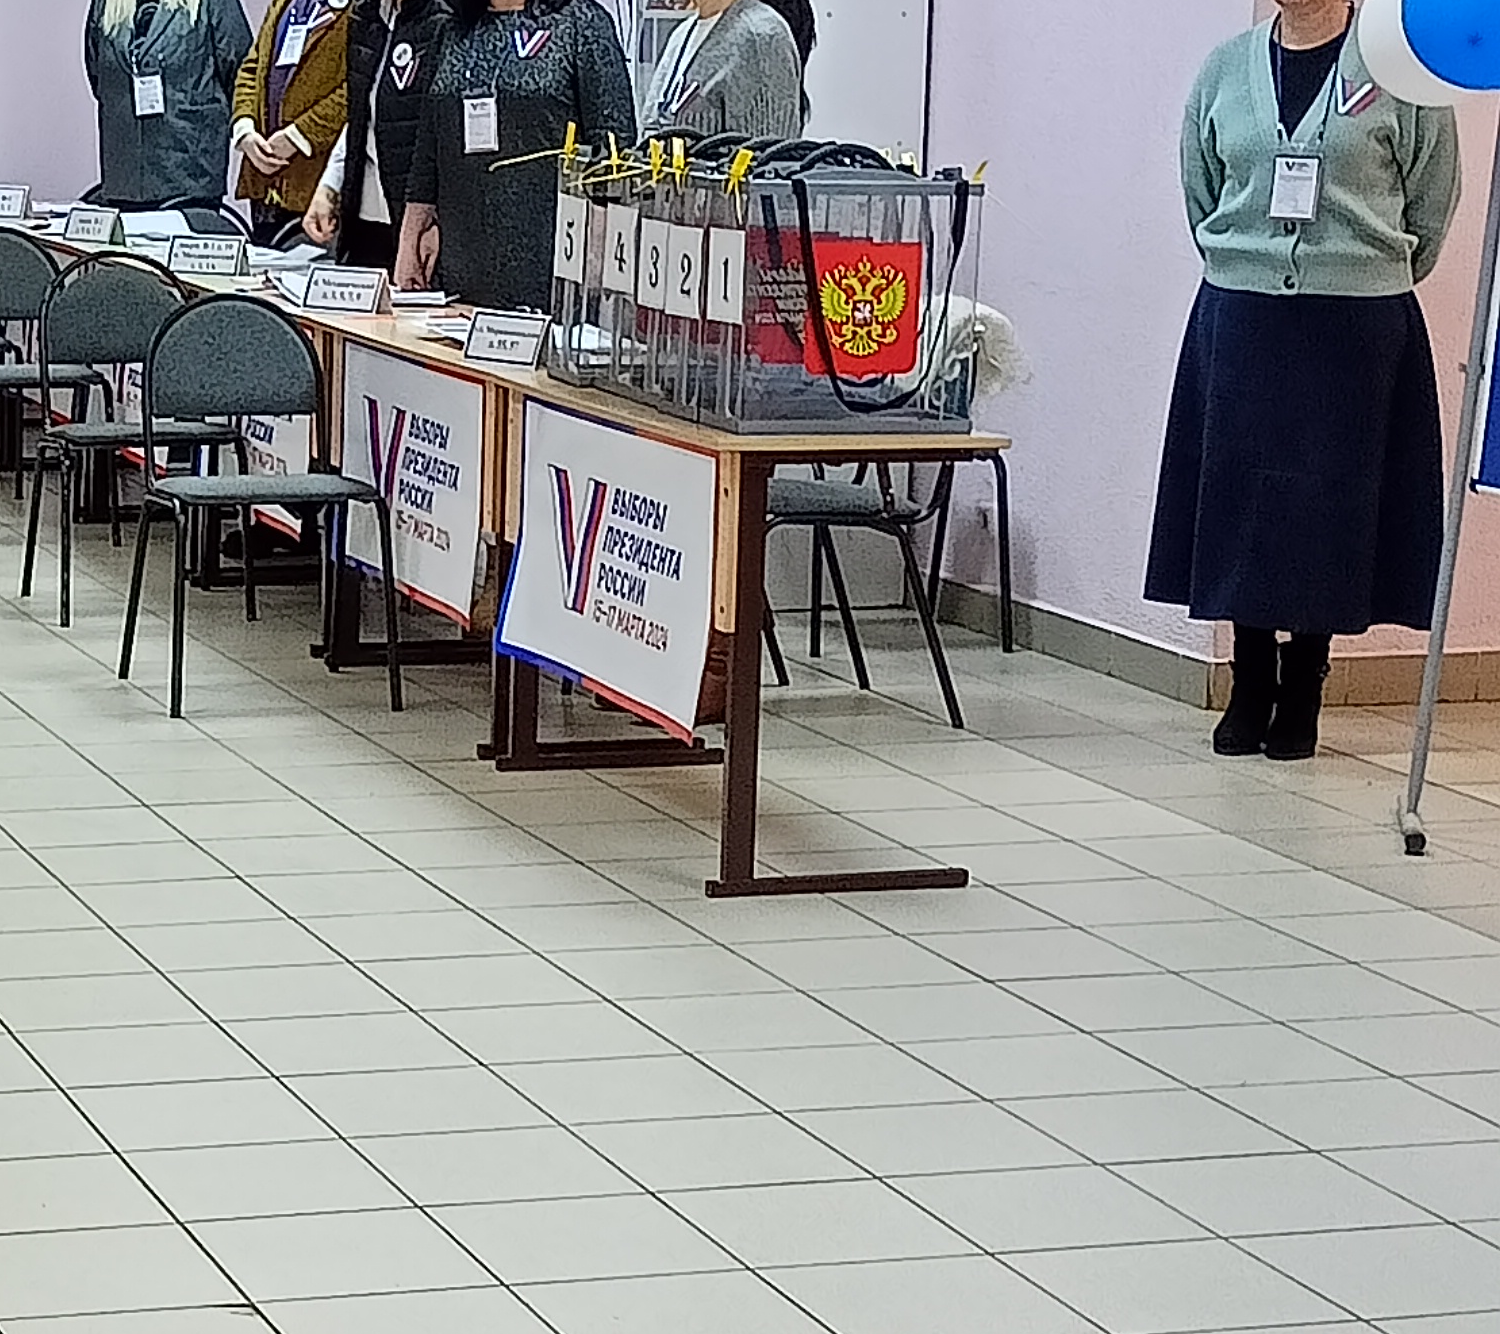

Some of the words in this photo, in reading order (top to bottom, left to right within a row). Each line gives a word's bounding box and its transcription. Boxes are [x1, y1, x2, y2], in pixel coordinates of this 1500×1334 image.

[564, 218, 575, 262] 5
[614, 231, 627, 274] 4
[649, 245, 660, 288] 3
[680, 253, 692, 297] 2
[722, 257, 729, 303] 1
[409, 413, 450, 451] ВЫБОРЫ
[611, 487, 669, 533] ВЫБОРЫ
[602, 524, 684, 581] ПРЕЗИДЕНТА
[597, 562, 647, 607] РОССИИ
[615, 608, 647, 643] МАРТА
